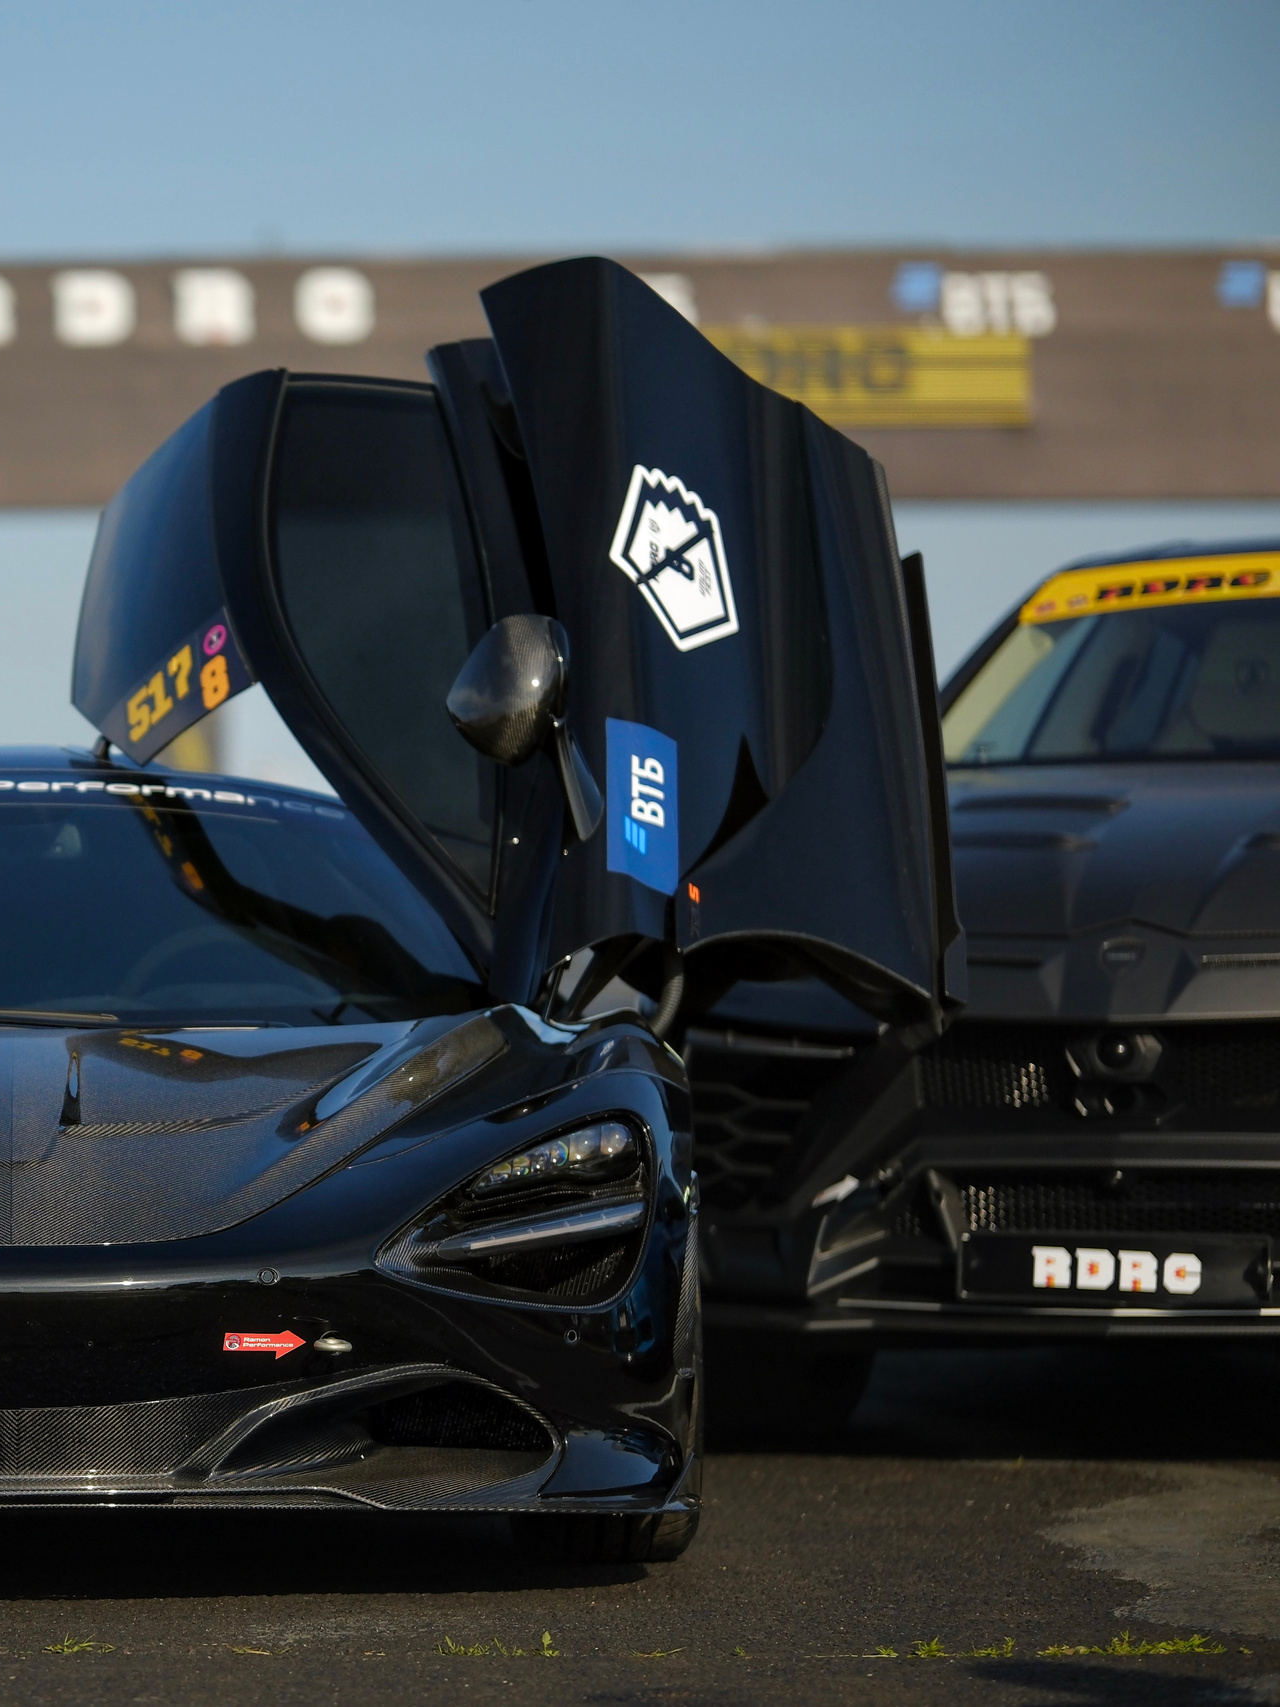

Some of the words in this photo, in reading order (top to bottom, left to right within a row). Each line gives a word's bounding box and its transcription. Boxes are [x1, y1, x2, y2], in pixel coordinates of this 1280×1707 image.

[126, 644, 193, 743] 517
[200, 655, 231, 710] 8
[631, 755, 665, 828] ВТБ
[1031, 1244, 1203, 1295] RDRC
